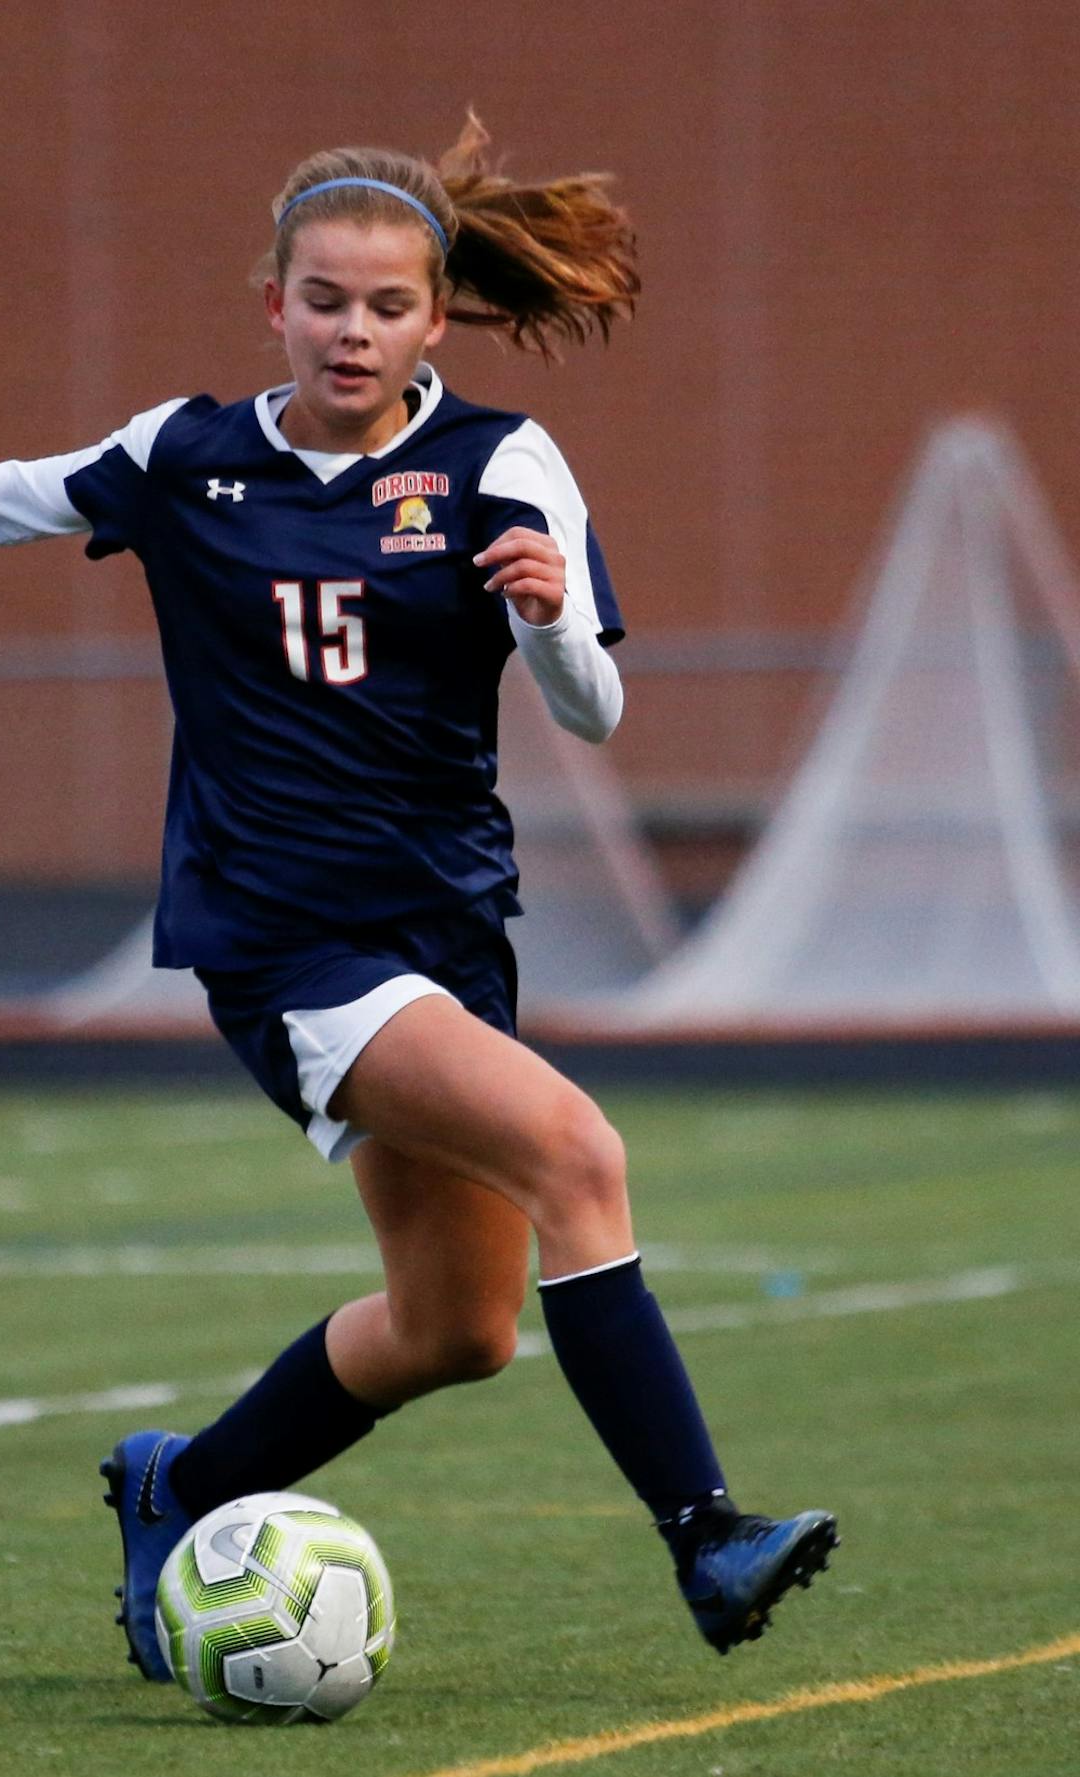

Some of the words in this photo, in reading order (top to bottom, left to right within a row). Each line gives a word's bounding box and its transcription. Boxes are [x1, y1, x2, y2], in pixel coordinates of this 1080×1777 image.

[372, 470, 449, 508] ORONO
[379, 533, 446, 554] SOCCER
[272, 579, 367, 685] 15
